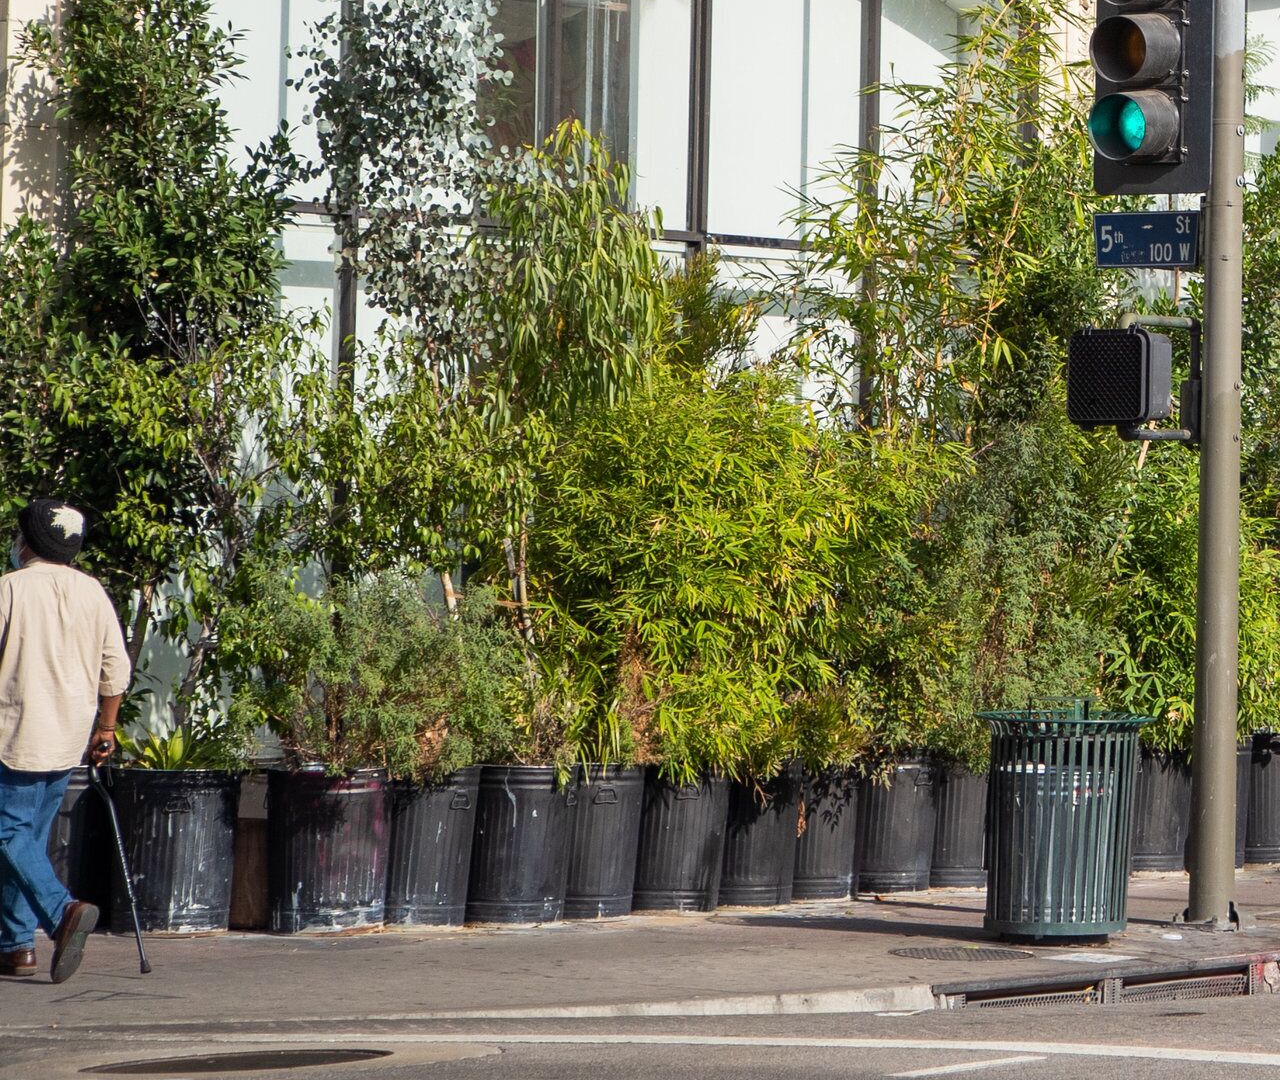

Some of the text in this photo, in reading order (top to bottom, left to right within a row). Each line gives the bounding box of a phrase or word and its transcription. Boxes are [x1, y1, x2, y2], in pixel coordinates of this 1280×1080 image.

[1101, 216, 1190, 253] 5th St
[1150, 243, 1190, 262] 100 W
